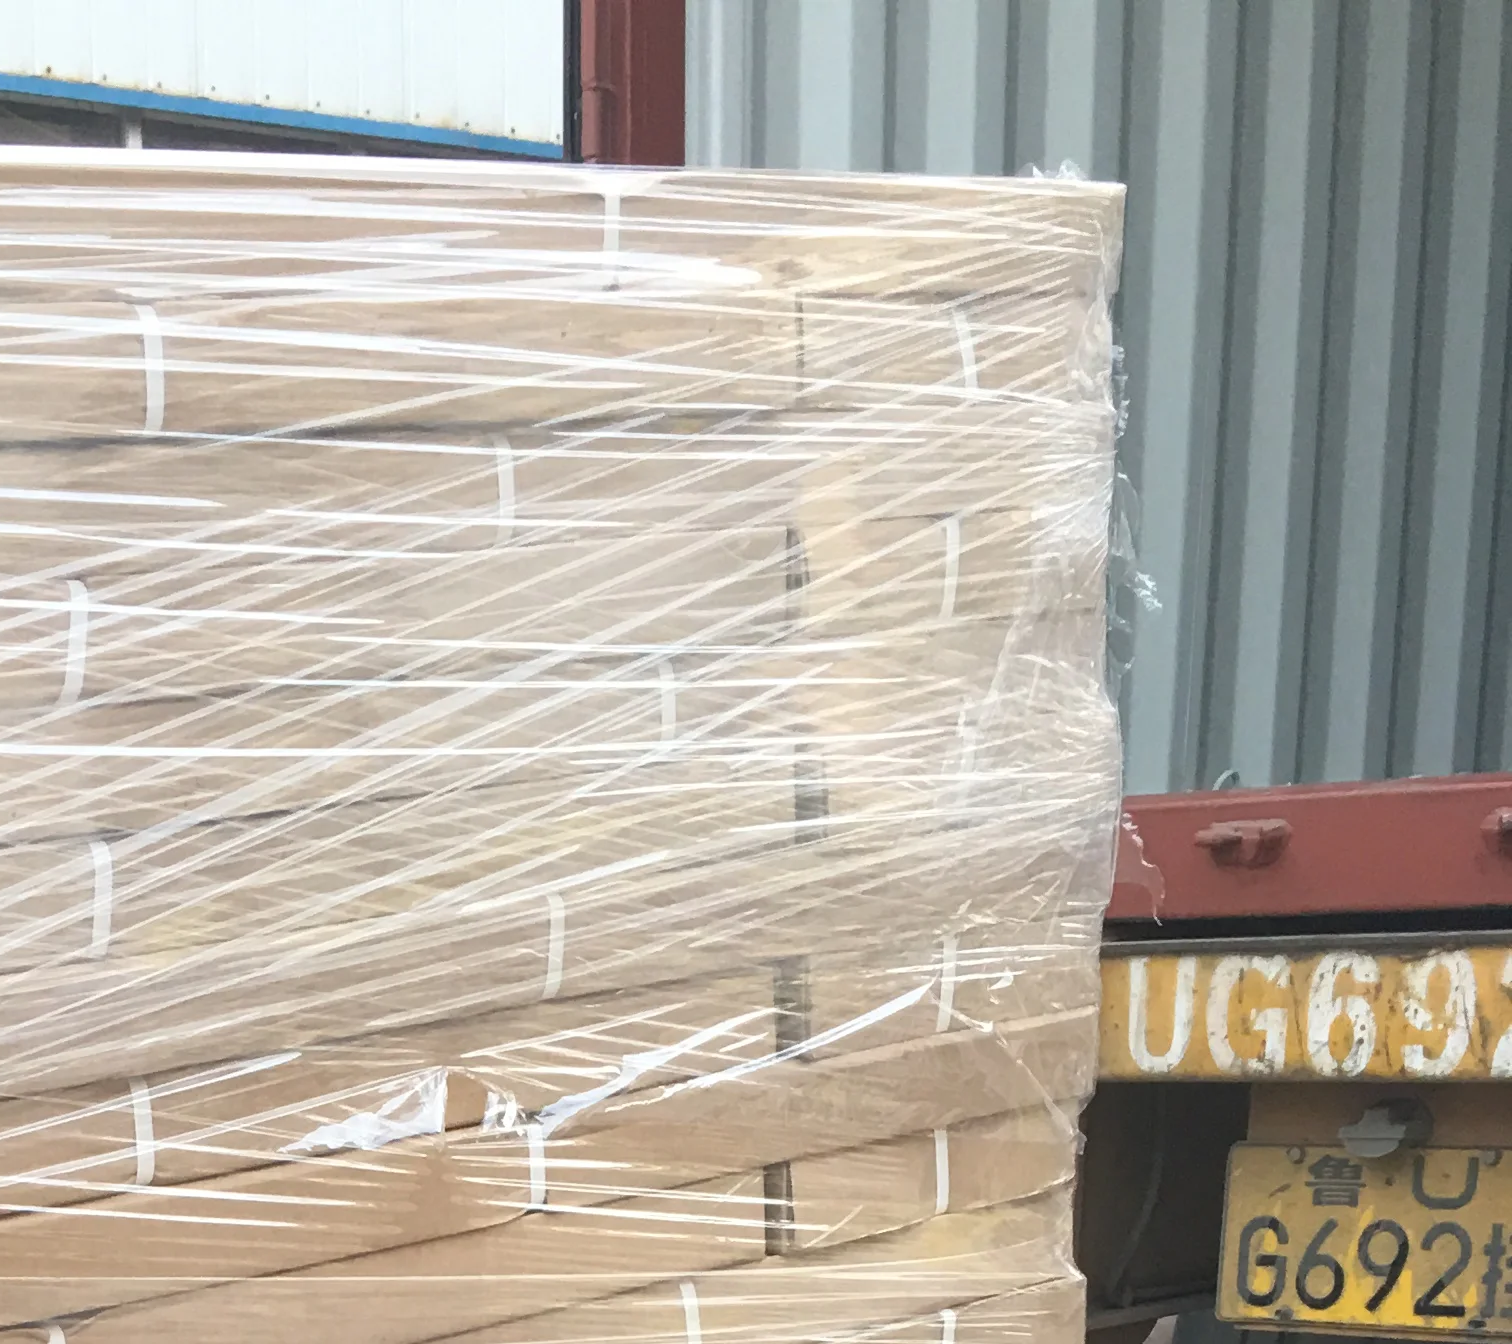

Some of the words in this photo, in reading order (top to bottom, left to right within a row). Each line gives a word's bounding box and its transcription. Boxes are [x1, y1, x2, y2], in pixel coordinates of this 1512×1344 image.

[1128, 949, 1512, 1077] UG69
[1305, 1154, 1366, 1207] 鲁
[1412, 1156, 1479, 1210] U
